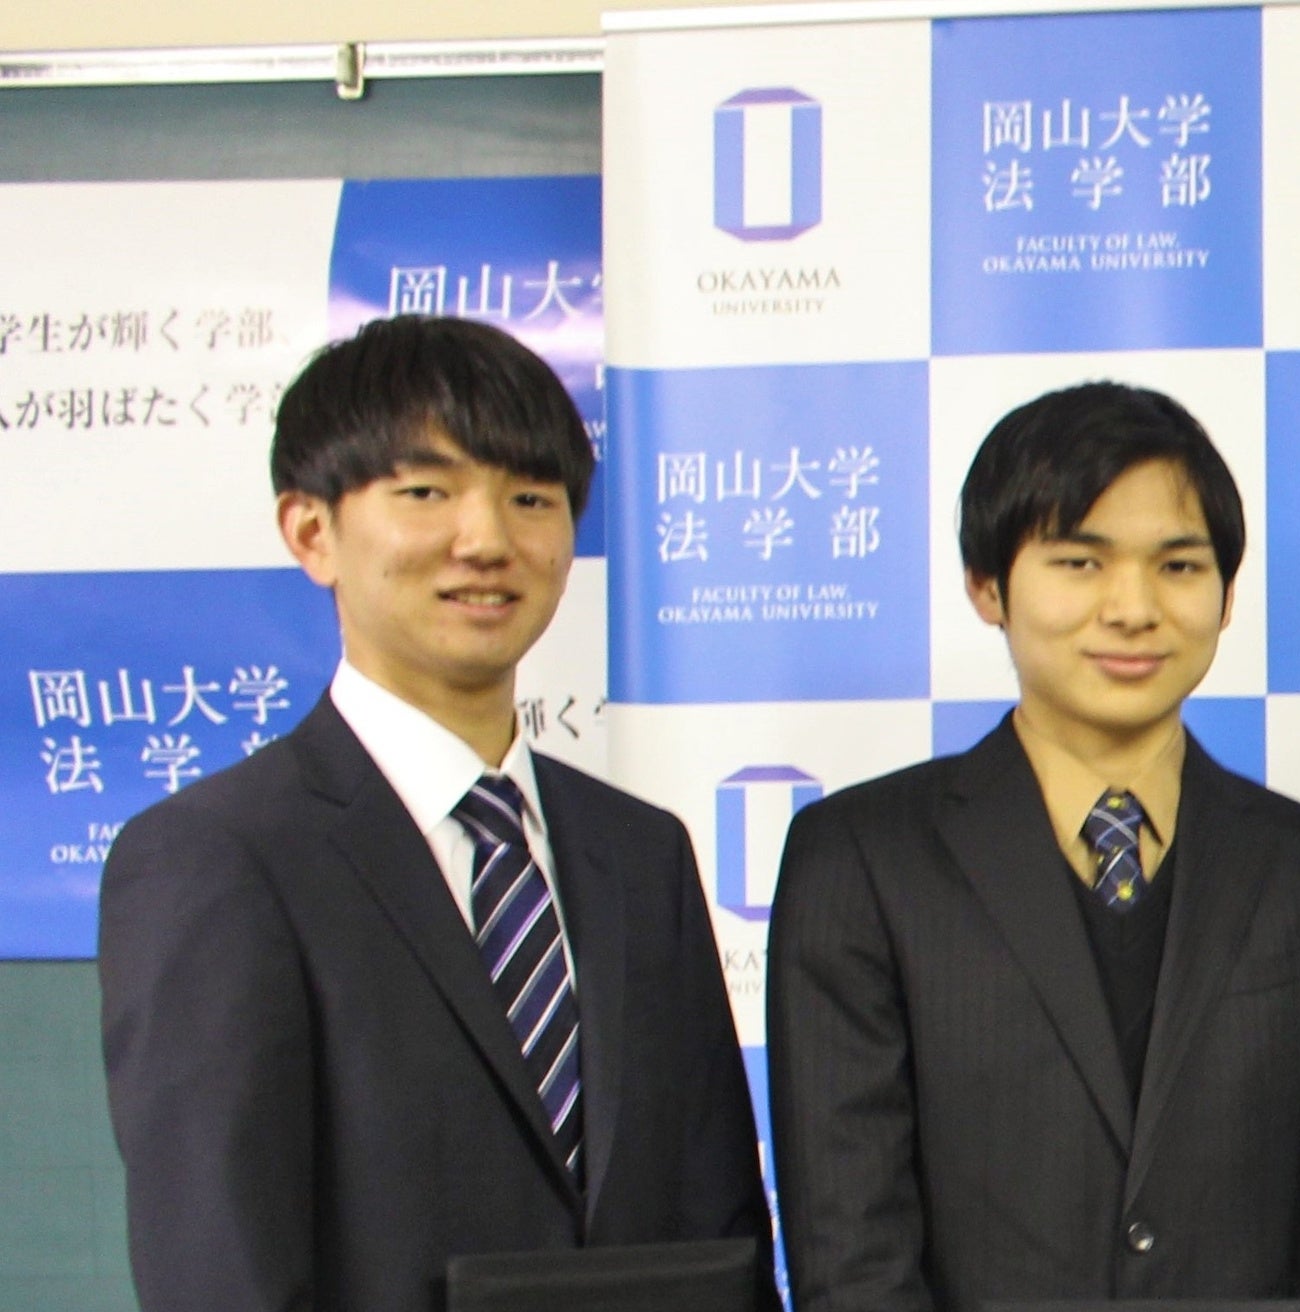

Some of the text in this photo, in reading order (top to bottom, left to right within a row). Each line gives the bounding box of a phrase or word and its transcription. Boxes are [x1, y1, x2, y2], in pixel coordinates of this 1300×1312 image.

[982, 94, 1211, 153] 岡山大学
[982, 154, 1211, 211] 法学部
[983, 250, 1209, 273] OKAYAMA UNIVERSITY
[1017, 234, 1099, 253] FACULTY
[1106, 233, 1128, 250] OF
[389, 262, 603, 318] 岡山大
[697, 267, 841, 294] OKAYAMA
[712, 298, 824, 316] UNIVERSITY
[0, 383, 283, 429] が羽ばたく学
[657, 446, 879, 504] 岡山大学
[656, 505, 879, 563] 法学部
[658, 602, 879, 624] OKAYAMA UNIVERSITY
[692, 585, 771, 603] FACULTY
[776, 584, 799, 600] OF
[29, 666, 290, 728] 岡山大学
[41, 732, 279, 794] 法学
[50, 844, 110, 863] OKAY
